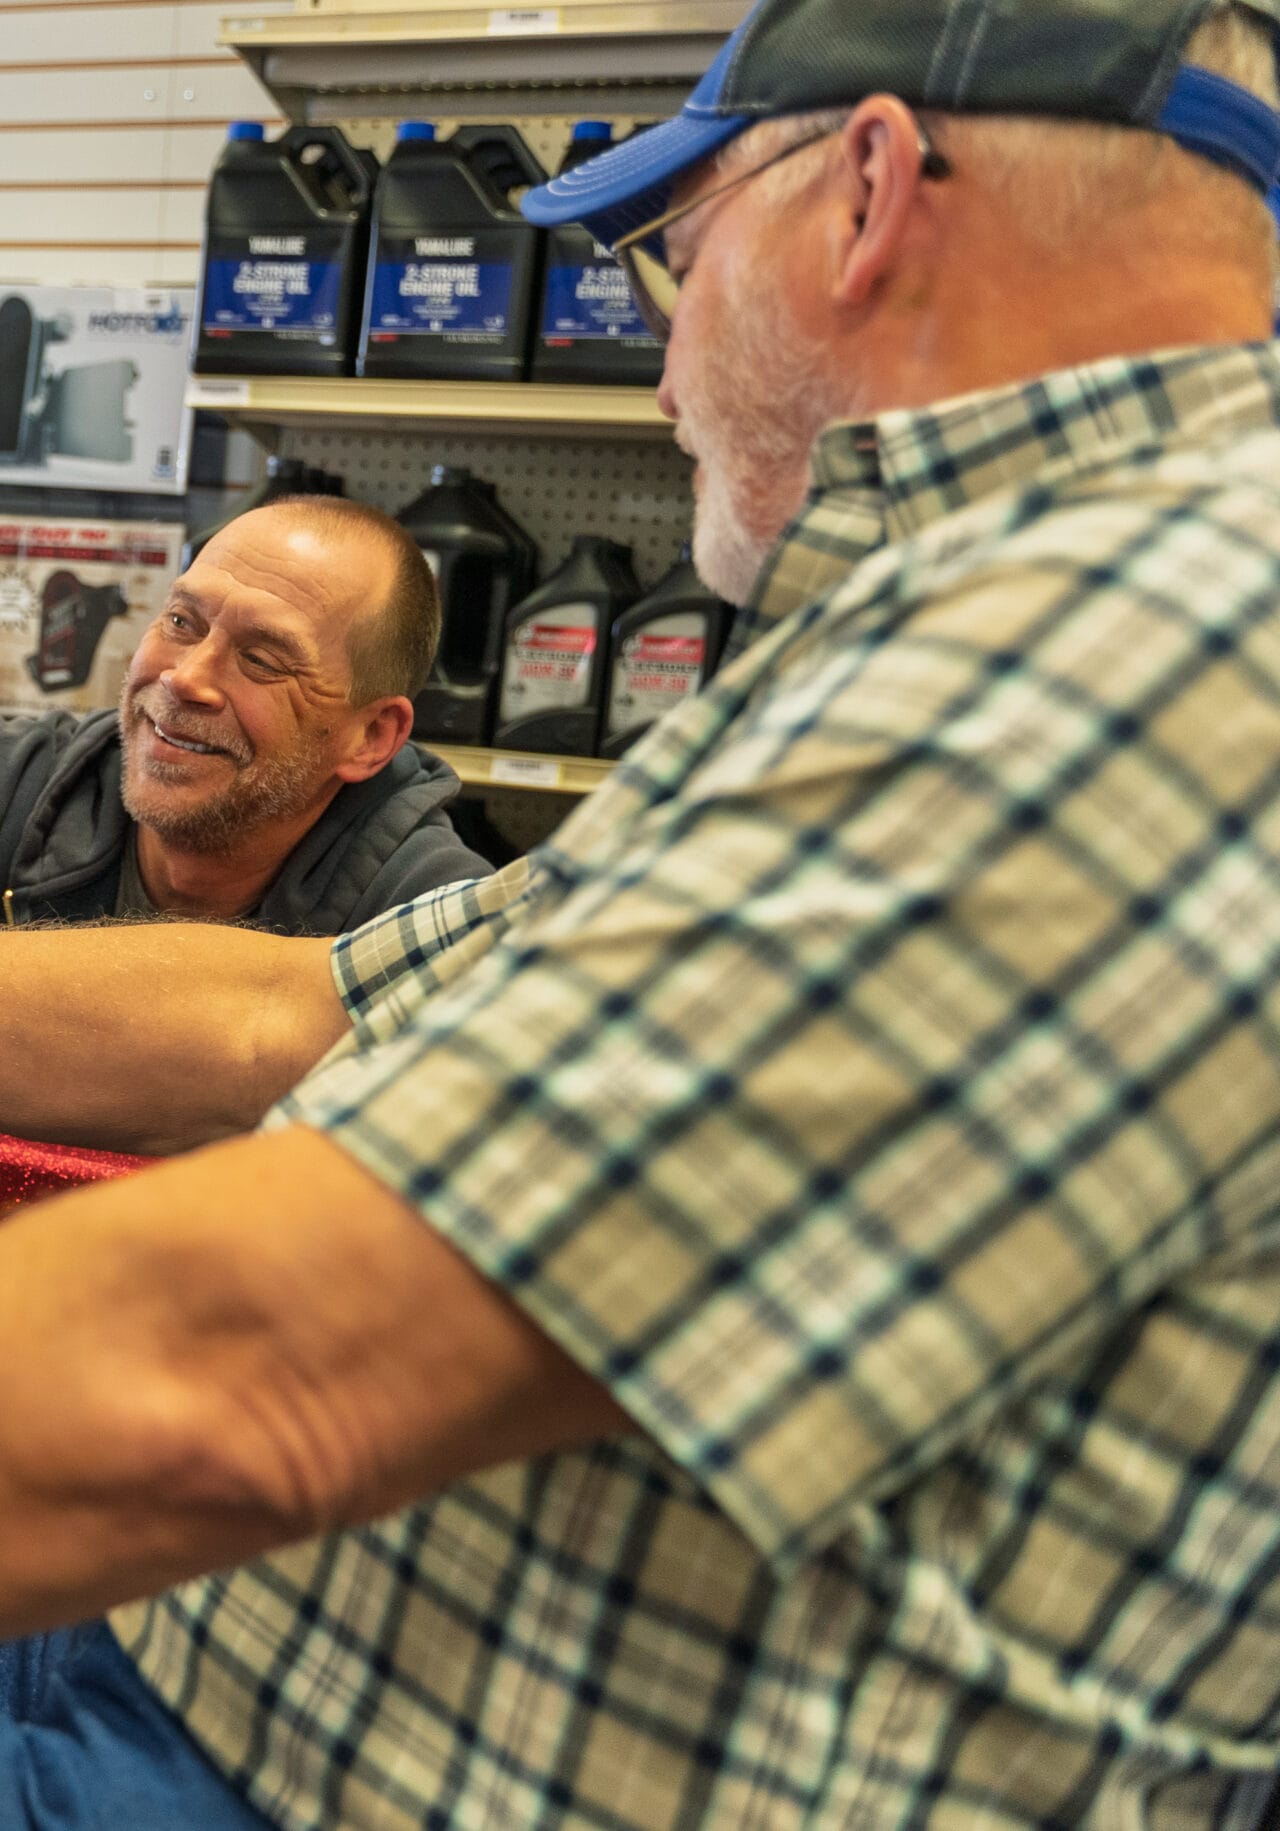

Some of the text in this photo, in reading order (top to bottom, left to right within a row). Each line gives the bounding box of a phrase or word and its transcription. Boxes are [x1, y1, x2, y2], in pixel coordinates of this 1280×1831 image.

[239, 261, 309, 281] 2-STROKE
[405, 263, 480, 282] 2-STROKE
[233, 279, 310, 295] ENGINE OIL
[398, 280, 481, 297] ENGINE OIL
